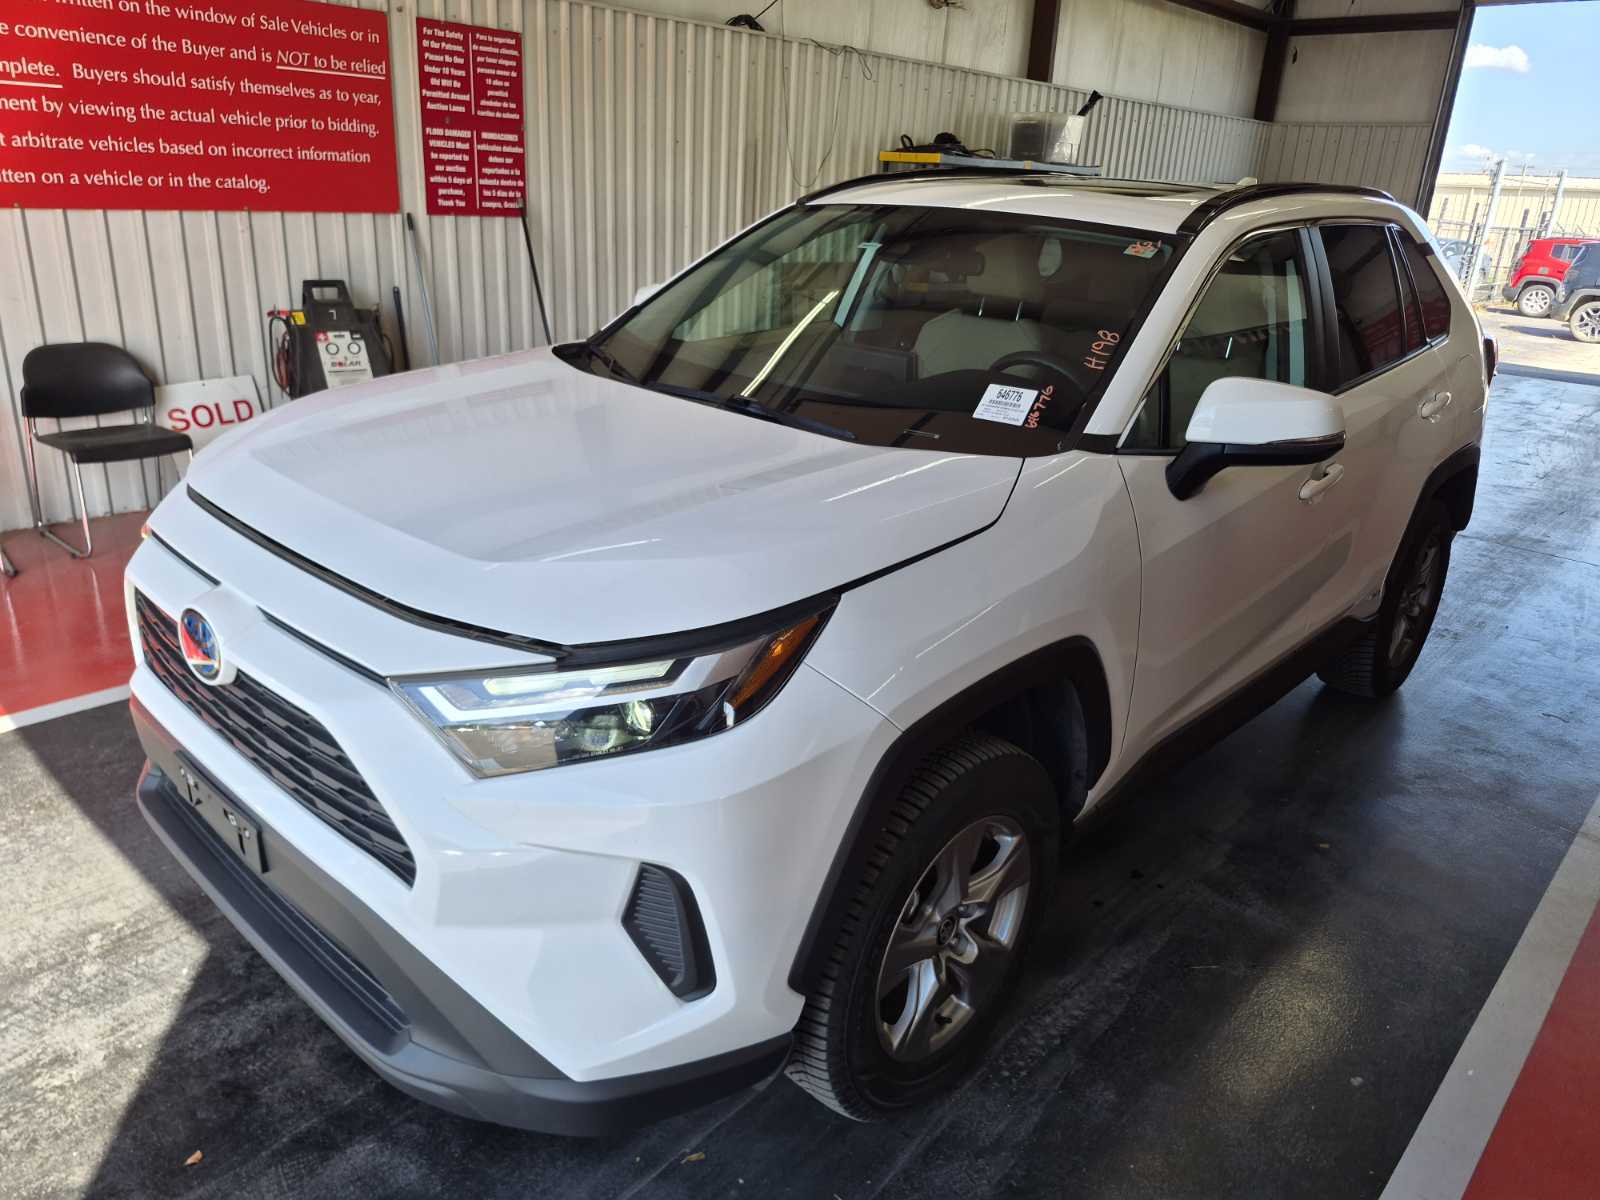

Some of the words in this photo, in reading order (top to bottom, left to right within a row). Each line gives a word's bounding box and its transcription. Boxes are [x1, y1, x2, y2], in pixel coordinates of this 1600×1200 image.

[118, 0, 140, 14] on
[145, 0, 171, 17] the
[175, 5, 236, 26] window
[241, 13, 256, 28] of
[260, 15, 289, 32] Sale
[291, 19, 347, 40] Vehicles
[350, 31, 363, 42] or
[368, 29, 380, 44] in
[423, 27, 432, 35] For
[435, 29, 444, 37] The
[14, 24, 126, 47] convenience
[131, 33, 148, 49] of
[152, 34, 177, 53] the
[182, 39, 225, 60] Buyer
[230, 47, 257, 62] and
[261, 49, 272, 63] is
[276, 50, 311, 66] NOT
[313, 55, 327, 69] to
[331, 55, 347, 71] be
[351, 60, 386, 75] relied
[72, 63, 128, 85] Buyers
[132, 68, 186, 88] should
[191, 75, 235, 96] satisfy
[240, 78, 316, 99] themselves
[319, 90, 332, 101] as
[336, 89, 350, 102] to
[352, 92, 382, 105] year,
[42, 96, 63, 118] by
[68, 100, 137, 123] viewing
[140, 103, 166, 120] the
[170, 108, 215, 123] actual
[220, 109, 272, 127] vehicle
[275, 114, 308, 131] prior
[311, 118, 325, 131] to
[328, 117, 380, 138] bidding.
[11, 131, 84, 151] arbitrate
[88, 135, 155, 154] vehicles
[159, 137, 203, 156] based
[208, 144, 227, 157] on
[231, 143, 293, 160] incorrect
[297, 145, 371, 163] information
[41, 172, 64, 185] on
[70, 173, 79, 185] a
[84, 169, 143, 187] vehicle
[147, 175, 164, 187] or
[169, 172, 183, 188] in
[188, 172, 211, 189] the
[215, 174, 271, 193] catalog.
[996, 388, 1024, 402] 646776
[168, 399, 254, 433] SOLD
